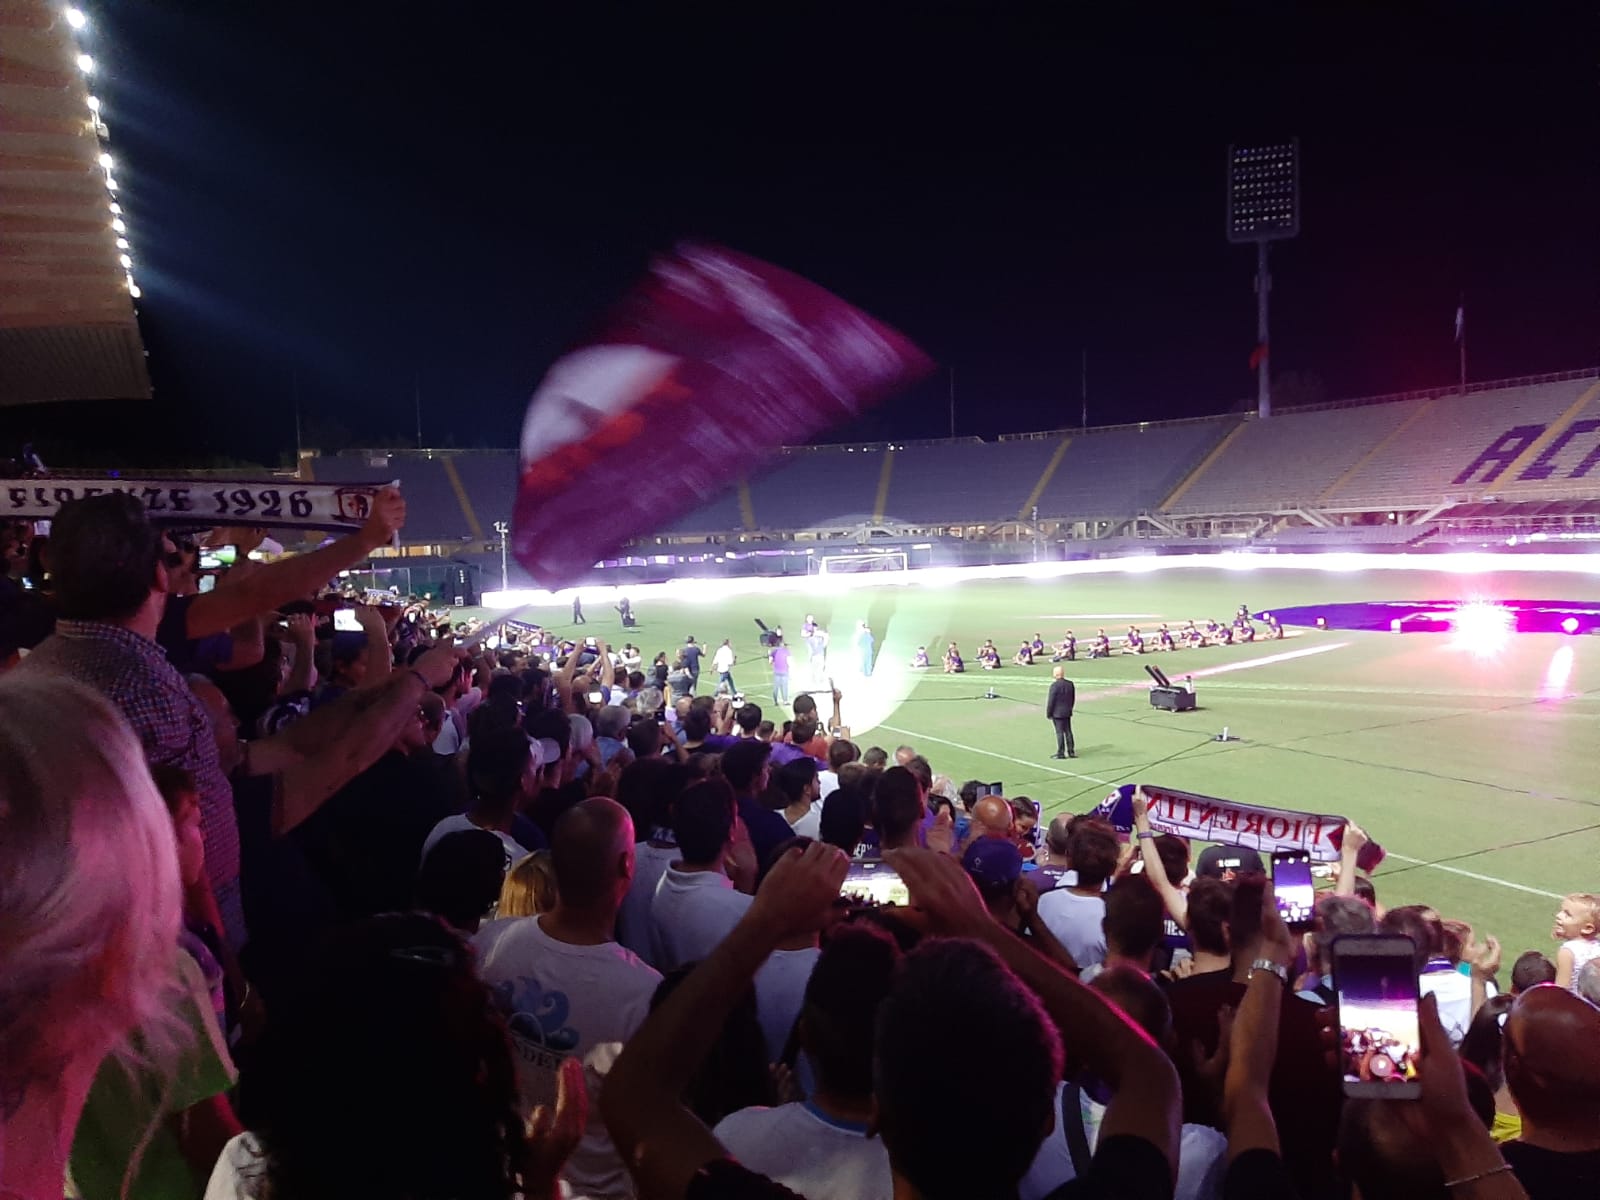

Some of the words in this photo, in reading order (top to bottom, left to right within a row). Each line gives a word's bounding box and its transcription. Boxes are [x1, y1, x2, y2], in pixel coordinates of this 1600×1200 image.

[1452, 419, 1600, 484] AC
[8, 487, 191, 512] FIRZE
[212, 488, 313, 518] 1926
